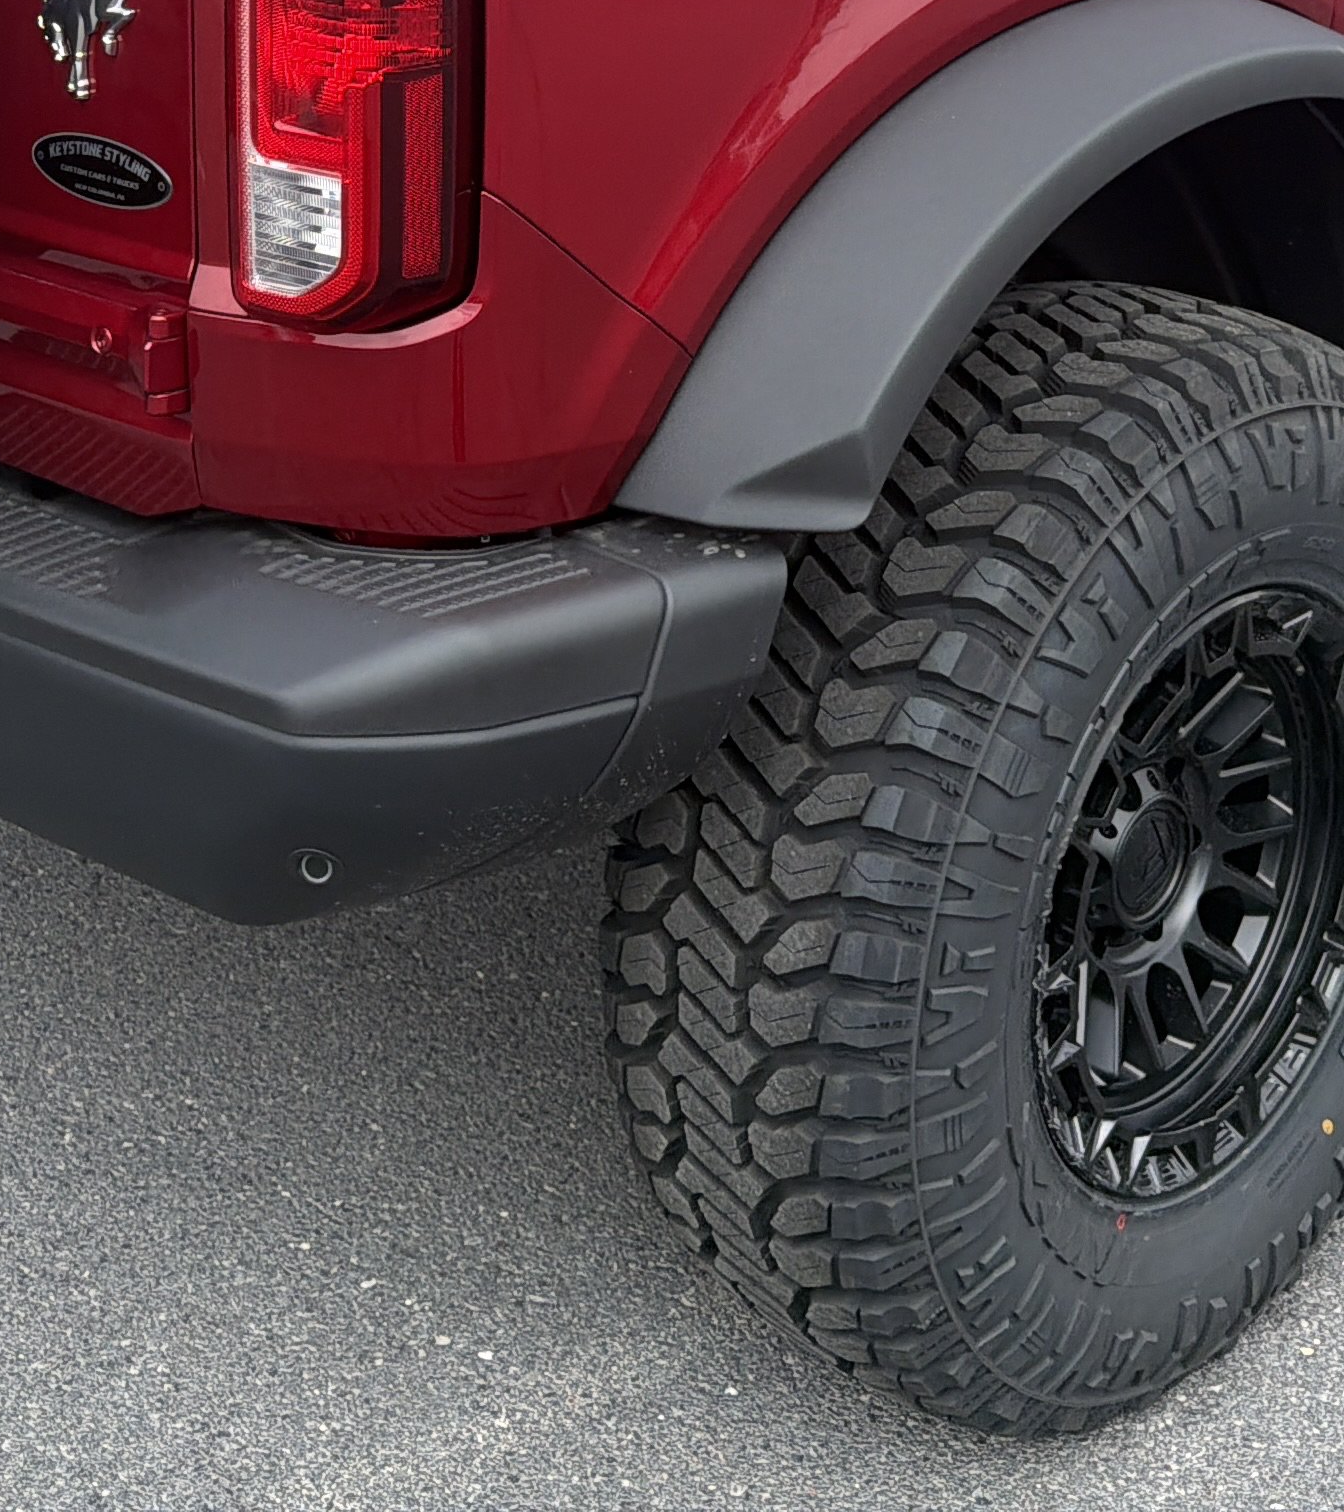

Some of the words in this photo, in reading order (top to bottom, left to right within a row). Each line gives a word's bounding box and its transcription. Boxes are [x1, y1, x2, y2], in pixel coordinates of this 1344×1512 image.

[49, 141, 104, 159] KEYSTONE
[104, 148, 151, 182] STYLING
[60, 164, 88, 176] CUSTOM
[88, 171, 106, 182] CARS
[113, 177, 140, 190] TRUCKS
